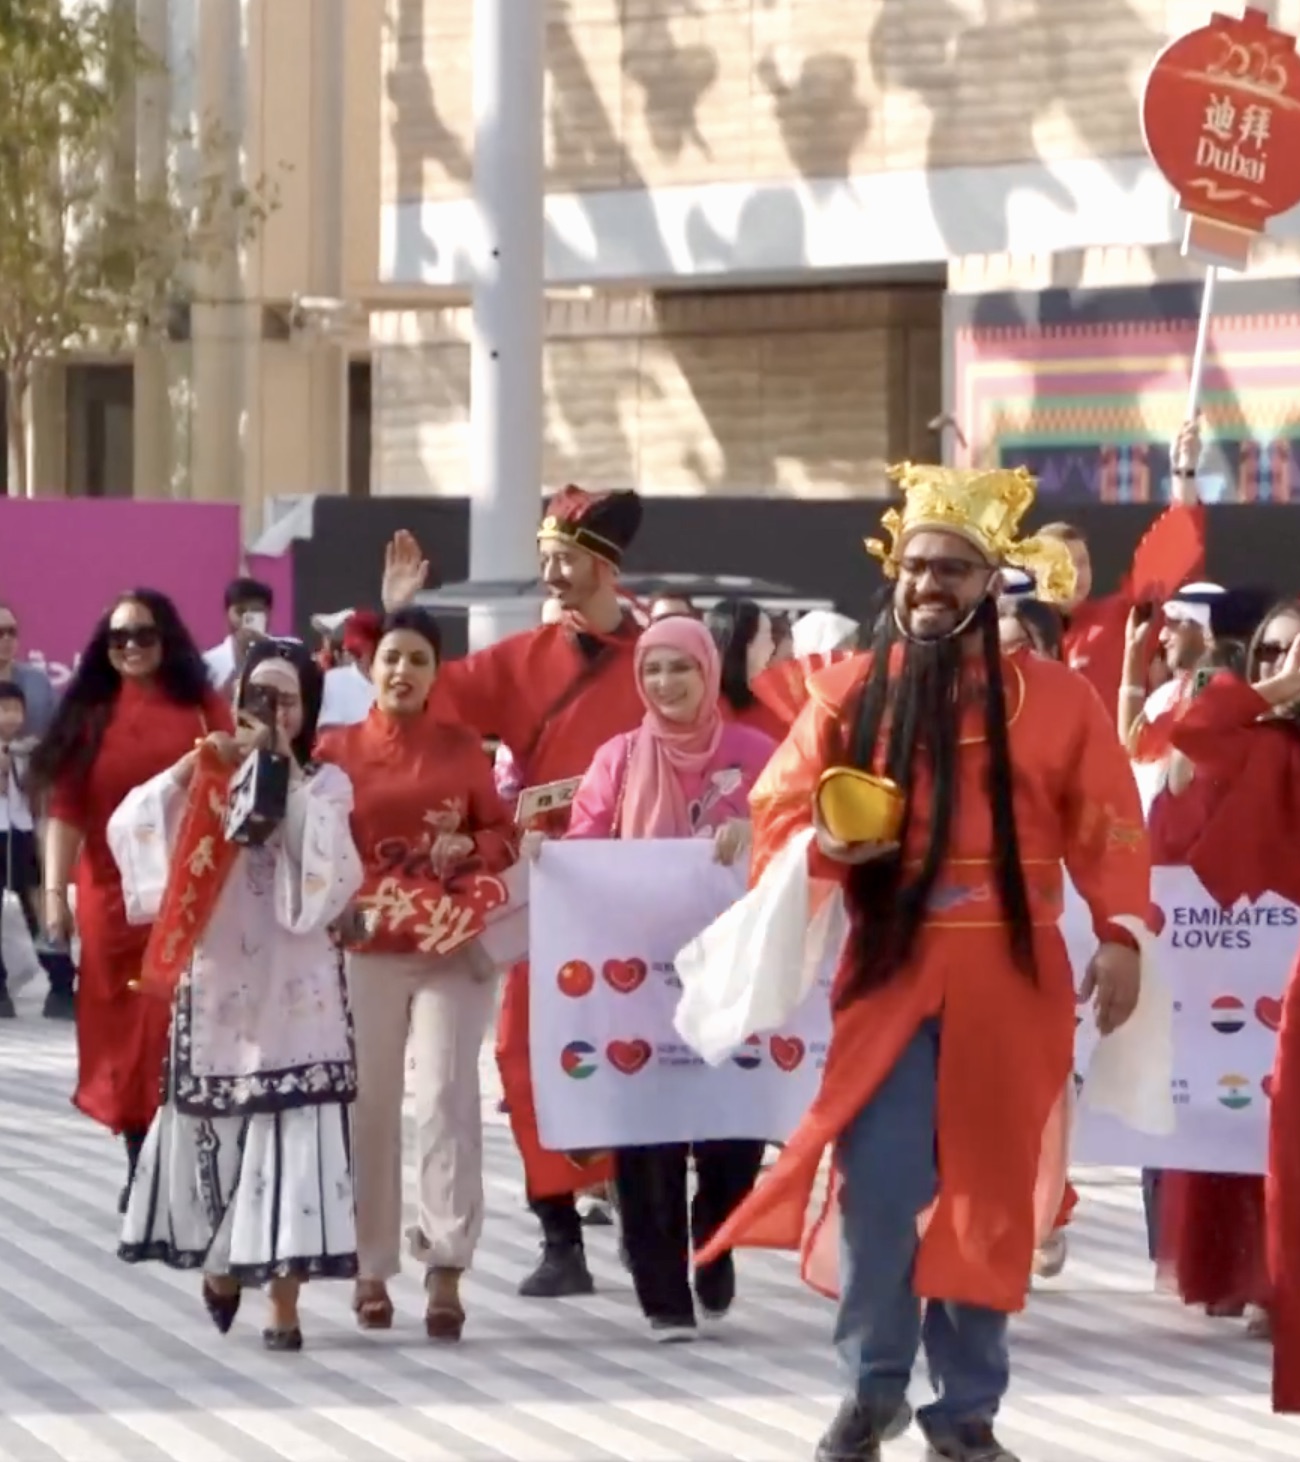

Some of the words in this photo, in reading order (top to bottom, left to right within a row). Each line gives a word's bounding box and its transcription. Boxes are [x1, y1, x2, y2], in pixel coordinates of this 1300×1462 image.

[1202, 93, 1272, 149] 迪拜
[1195, 136, 1267, 183] Dubai
[1172, 906, 1297, 927] EMIRATES
[1171, 929, 1251, 949] LOVES
